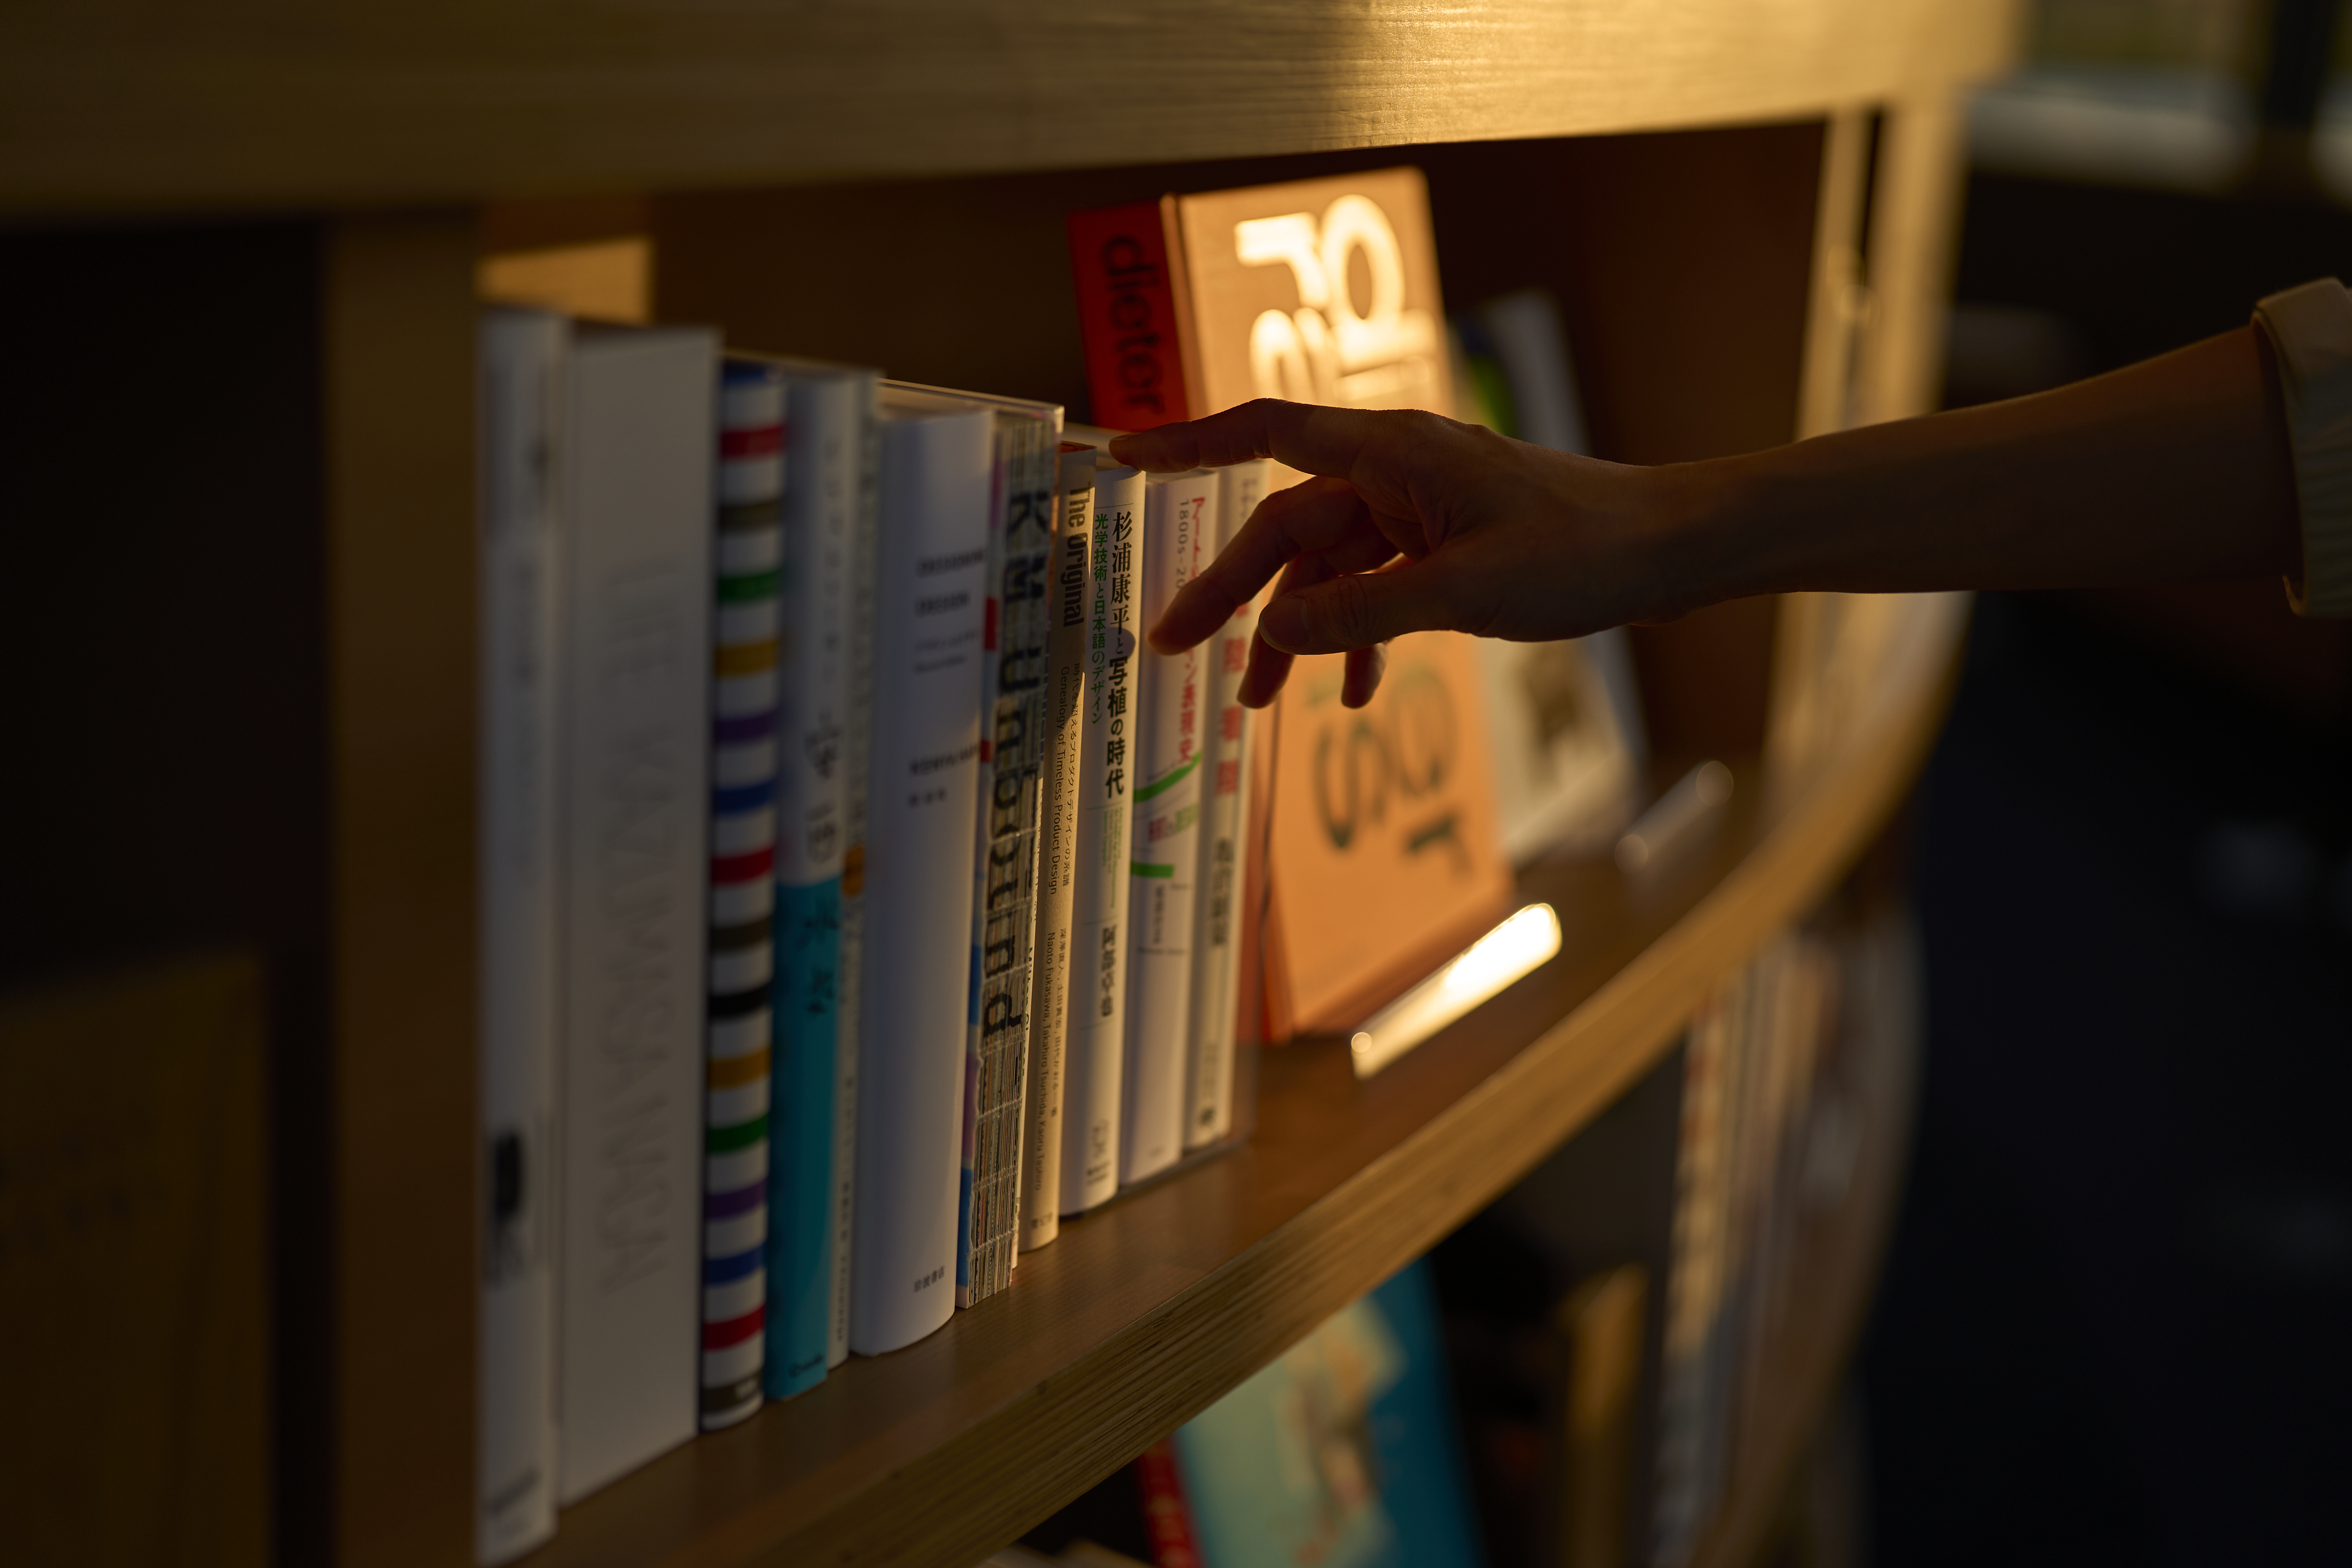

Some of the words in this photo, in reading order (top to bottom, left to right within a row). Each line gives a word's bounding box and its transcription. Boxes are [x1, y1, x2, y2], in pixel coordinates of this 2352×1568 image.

[1103, 235, 1168, 414] dieter
[1068, 482, 1092, 528] The
[1176, 499, 1189, 589] 1800s-20
[1061, 532, 1088, 627] Original
[1091, 514, 1108, 724] 光学技術と日本語のデザイン
[1105, 510, 1132, 798] 杉浦康平と写植の時代
[1057, 666, 1070, 729] Genealogy
[1058, 734, 1066, 745] of
[1055, 749, 1066, 800] Timeless
[1052, 804, 1063, 851] Product
[1048, 855, 1060, 895] Design
[1046, 932, 1055, 964] Naoto
[1043, 968, 1054, 1022] Fukasawa,
[1041, 1025, 1051, 1068] Takahiro
